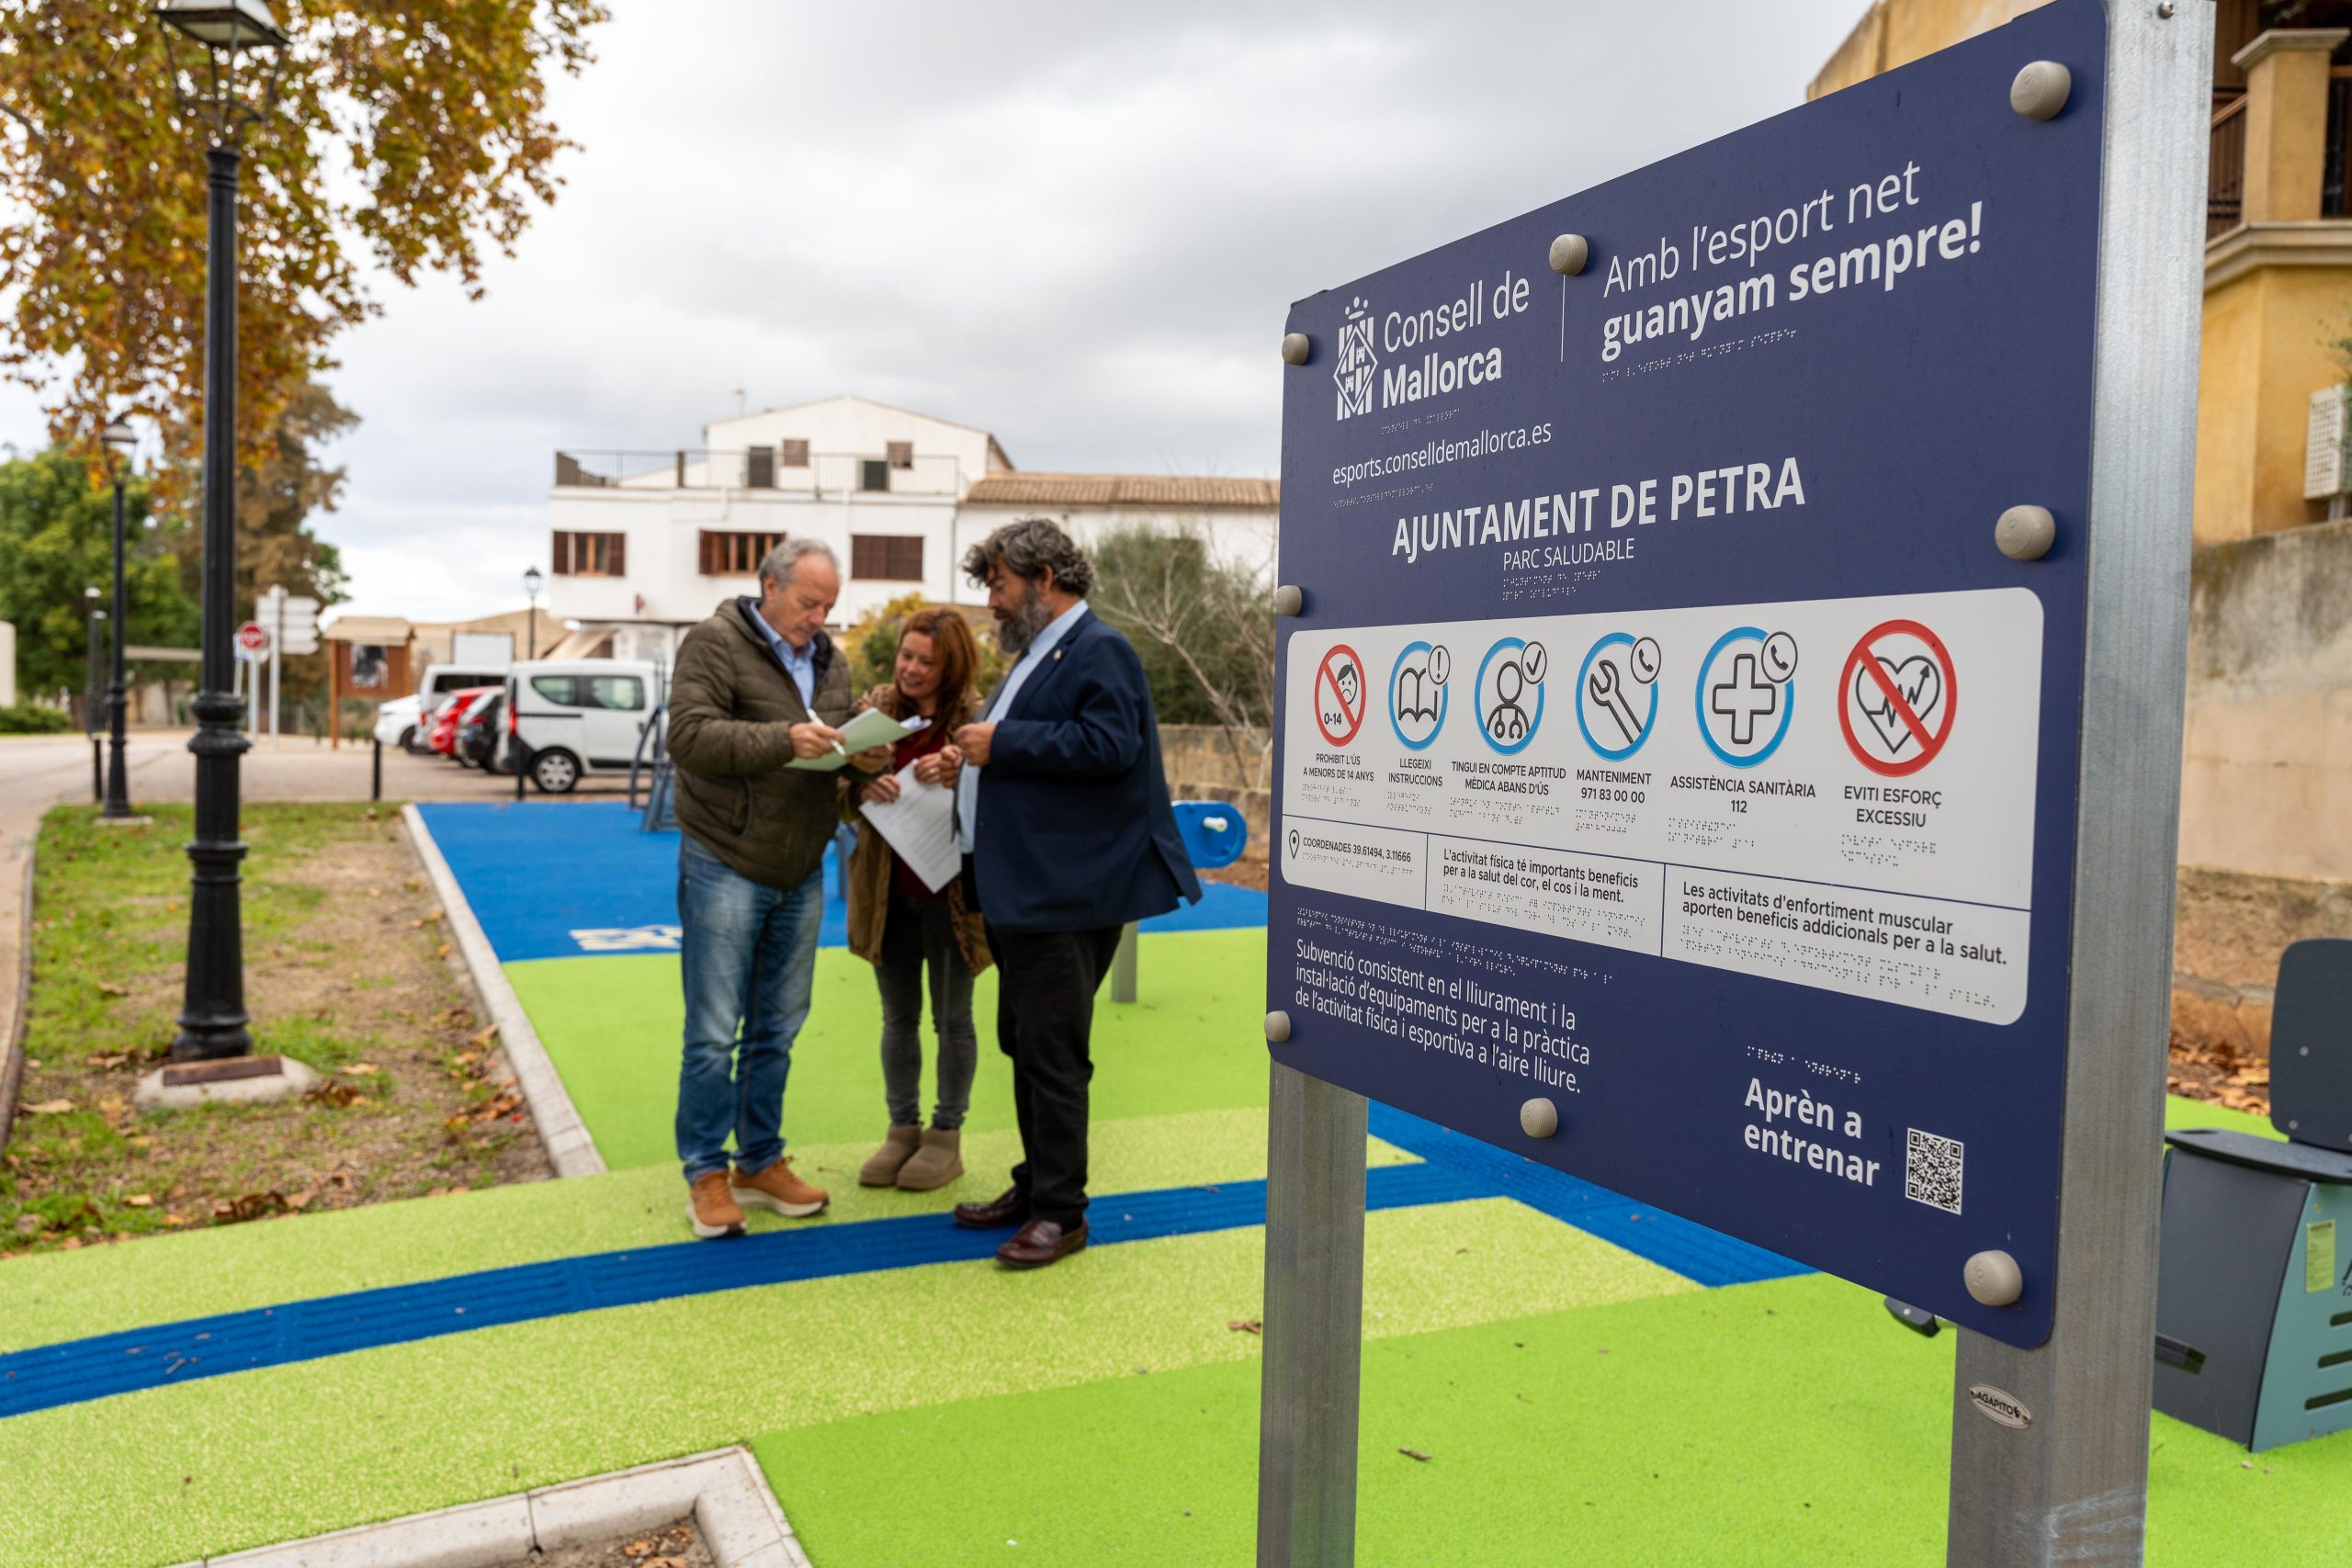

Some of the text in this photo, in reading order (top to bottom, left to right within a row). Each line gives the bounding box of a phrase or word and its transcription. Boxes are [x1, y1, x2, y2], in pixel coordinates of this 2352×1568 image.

[1603, 161, 1919, 298] Amb l'esport net
[1601, 200, 1982, 362] guanyam sempre!
[1384, 270, 1529, 352] Consell de
[1383, 346, 1501, 408] Mallorca
[1332, 423, 1551, 488] esports.conselldemallorca.es
[1392, 457, 1804, 563] AJUNTAMENT DE PETRA
[1503, 537, 1634, 570] PARC SALUDABLE
[1324, 713, 1341, 725] 0-14
[1303, 766, 1374, 781] A MENORS DE 14 ANYS
[1316, 752, 1344, 763] PROHIBIT
[1399, 758, 1431, 769] LLEGEIXI
[1452, 761, 1566, 779] TINGUI EN COMPTE APTITUD
[1388, 773, 1442, 786] INSTRUCCIONS
[1497, 781, 1526, 794] ABANS
[1577, 768, 1651, 784] MANTENIMENT
[1670, 774, 1815, 797] ASSISTÈNCIA SANITÀRIA
[1581, 786, 1645, 803] 971 83 00 00
[1731, 799, 1747, 812] 112
[1844, 785, 1941, 808] EVITI ESFORÇ
[1856, 807, 1925, 827] EXCESSIU
[1303, 837, 1410, 862] COORDENADES 39.61494, 3.11666
[1443, 848, 1637, 887] L'activitat física té importants beneficis
[1443, 864, 1623, 902] per a la salut del cor, el cos i la ment.
[1683, 881, 1952, 934] Les activitats d'enfortiment muscular
[1682, 901, 2006, 964] aporten beneficis addicionals per a la salut.
[1296, 938, 1575, 1030] Subvenció consistent en el lliurament i la
[1358, 979, 1456, 1026] d'equipaments
[1462, 1012, 1487, 1035] per
[1490, 1021, 1499, 1039] a
[1505, 1018, 1517, 1043] la
[1523, 1028, 1589, 1065] pràctica
[1295, 986, 1579, 1093] de l'activitat física i esportiva a l'aire lliure.
[1744, 1077, 1860, 1138] Aprèn a
[1744, 1123, 1879, 1186] entrenar
[1976, 1392, 2014, 1415] AGAPITO
